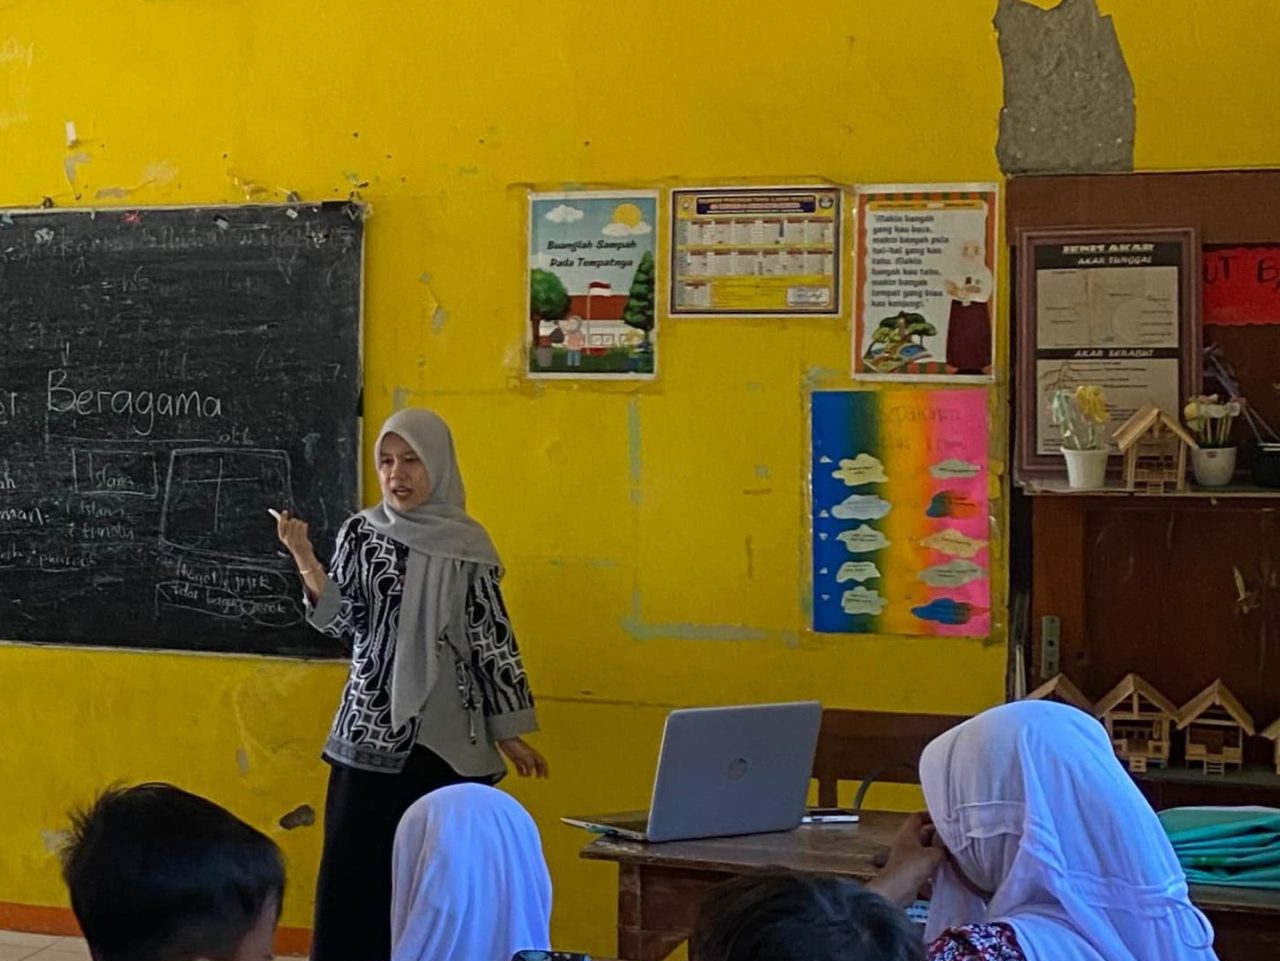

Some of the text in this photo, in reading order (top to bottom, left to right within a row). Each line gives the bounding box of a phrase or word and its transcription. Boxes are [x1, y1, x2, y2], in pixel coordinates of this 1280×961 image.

[547, 240, 637, 252] Buanglah Sampah
[1108, 243, 1155, 252] AKAR
[578, 257, 633, 269] Tempatnya
[47, 368, 223, 436] Beragama
